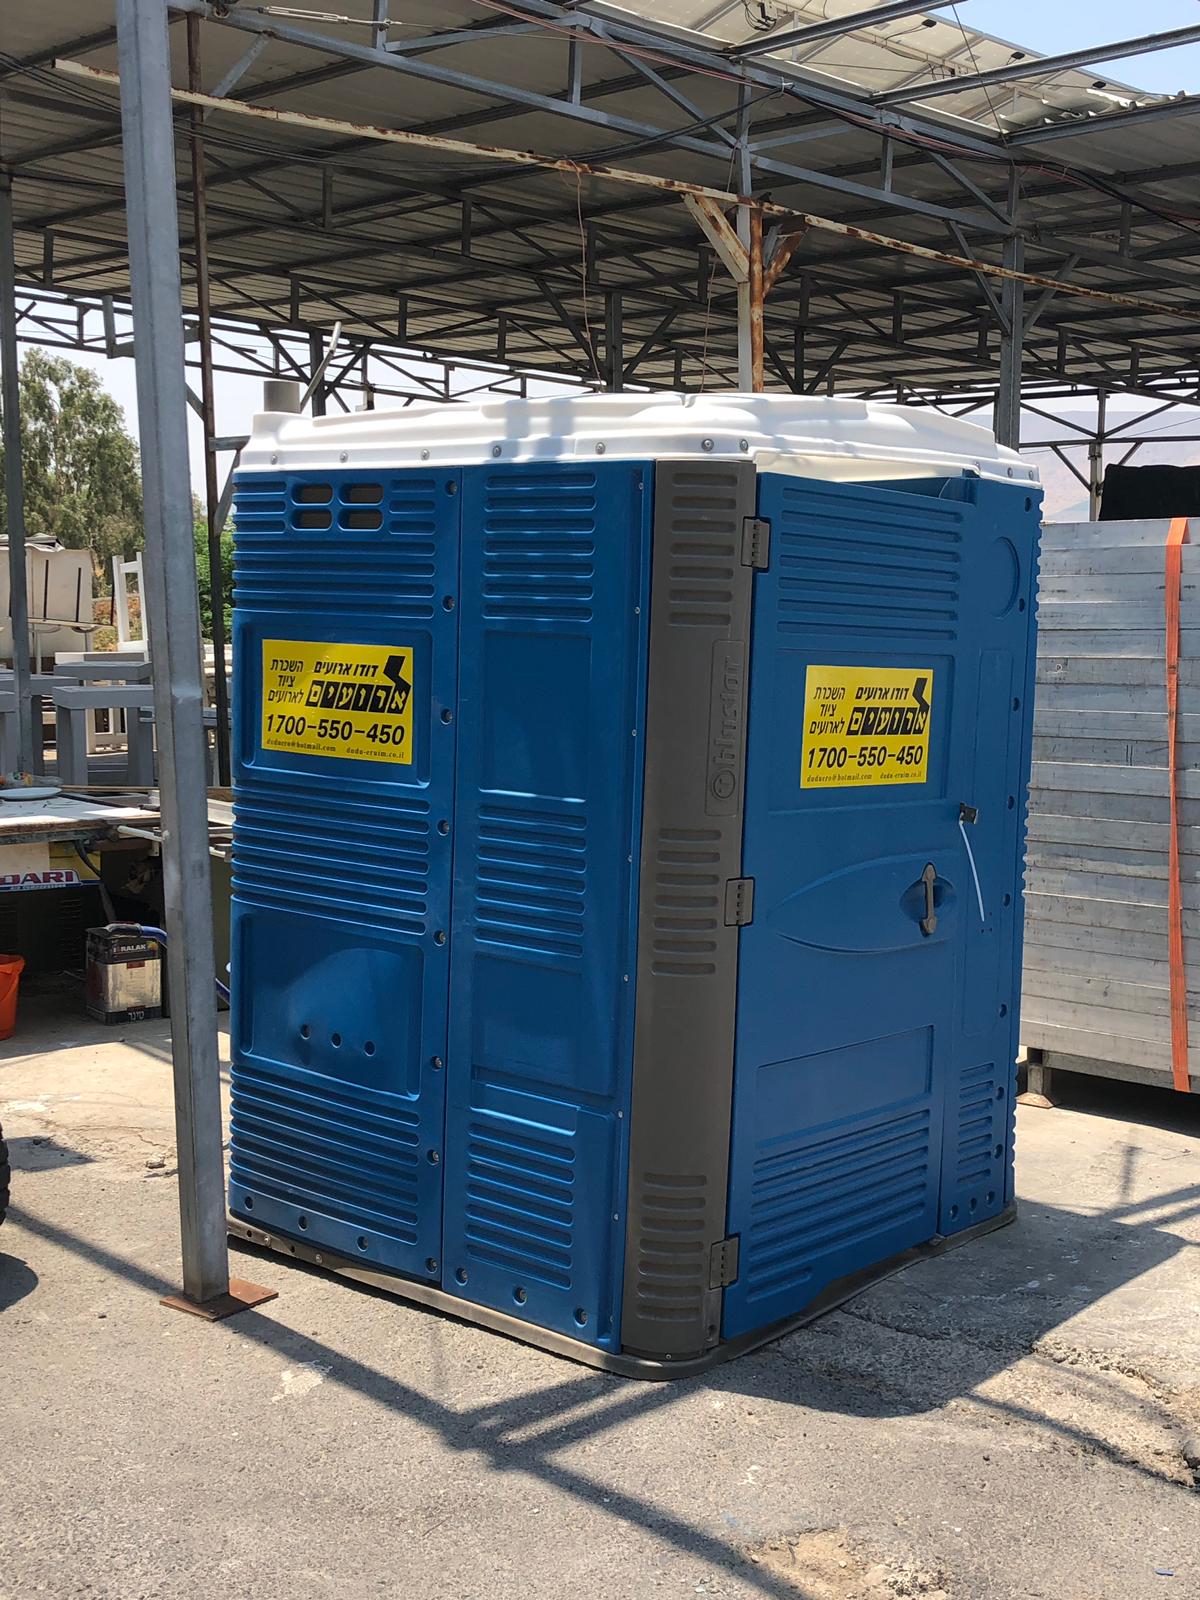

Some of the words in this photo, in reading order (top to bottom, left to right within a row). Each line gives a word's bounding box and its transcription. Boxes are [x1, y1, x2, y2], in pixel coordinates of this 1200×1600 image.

[270, 658, 304, 673] השכרת
[313, 660, 352, 676] ארועים
[352, 663, 379, 678] דודו
[277, 675, 296, 688] ציוד
[268, 689, 304, 704] לארועים
[308, 683, 408, 712] ארועים
[813, 686, 846, 700] השכרת
[855, 686, 890, 702] ארועים
[890, 687, 910, 700] דודו
[819, 703, 837, 717] ציוד
[809, 717, 846, 736] לארועים
[848, 708, 928, 735] ארועים
[266, 714, 405, 746] 1700-550-450
[807, 745, 924, 769] 1700-550-450
